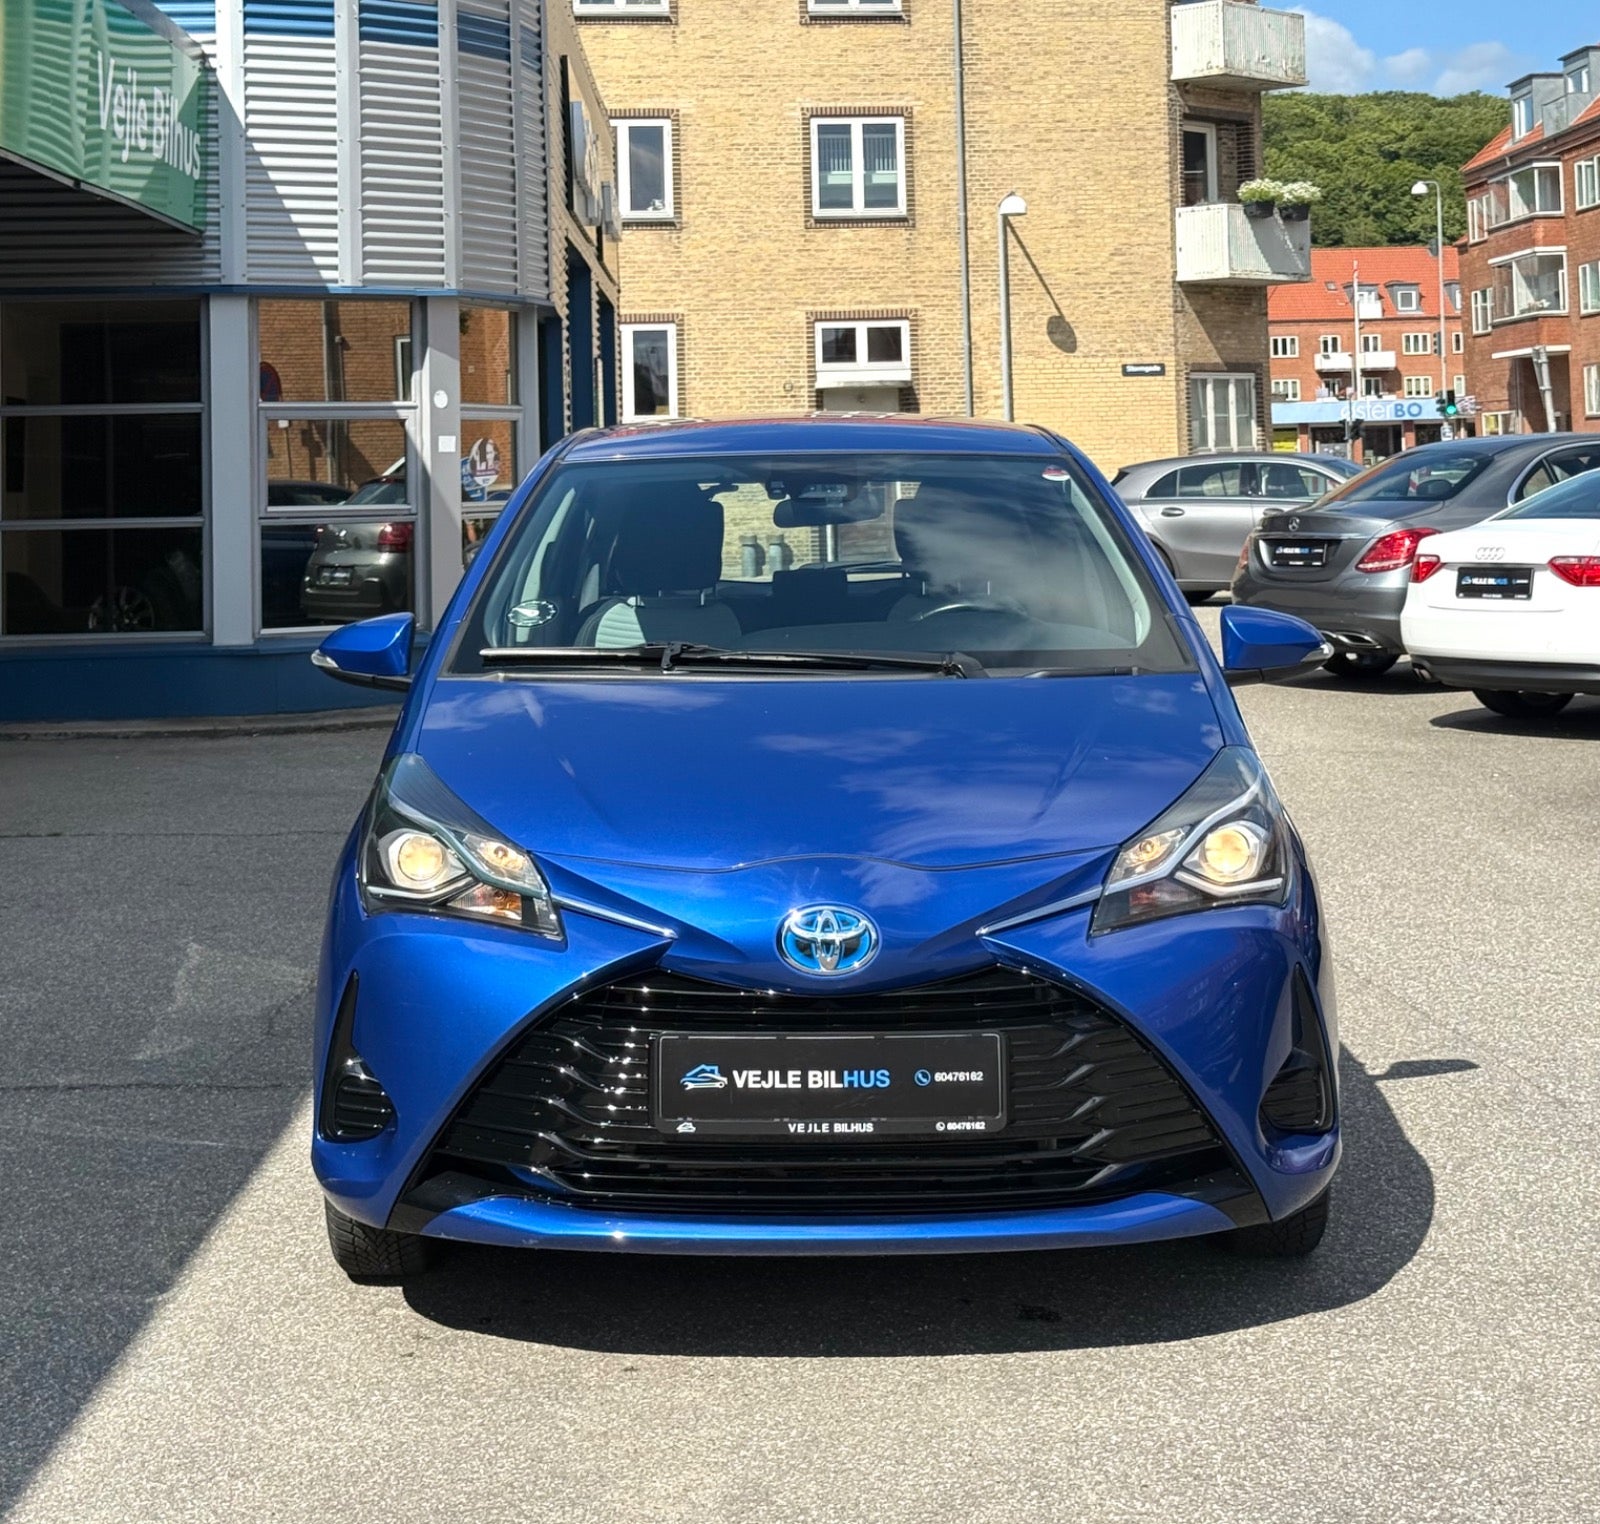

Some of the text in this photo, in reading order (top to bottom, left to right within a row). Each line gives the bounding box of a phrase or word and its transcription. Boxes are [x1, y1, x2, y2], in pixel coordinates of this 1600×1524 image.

[97, 50, 201, 181] Vejle Bilhus
[731, 1069, 891, 1089] VEJLE BILHUS
[933, 1071, 985, 1083] 60476162
[787, 1122, 875, 1134] VEJLE BILHUS
